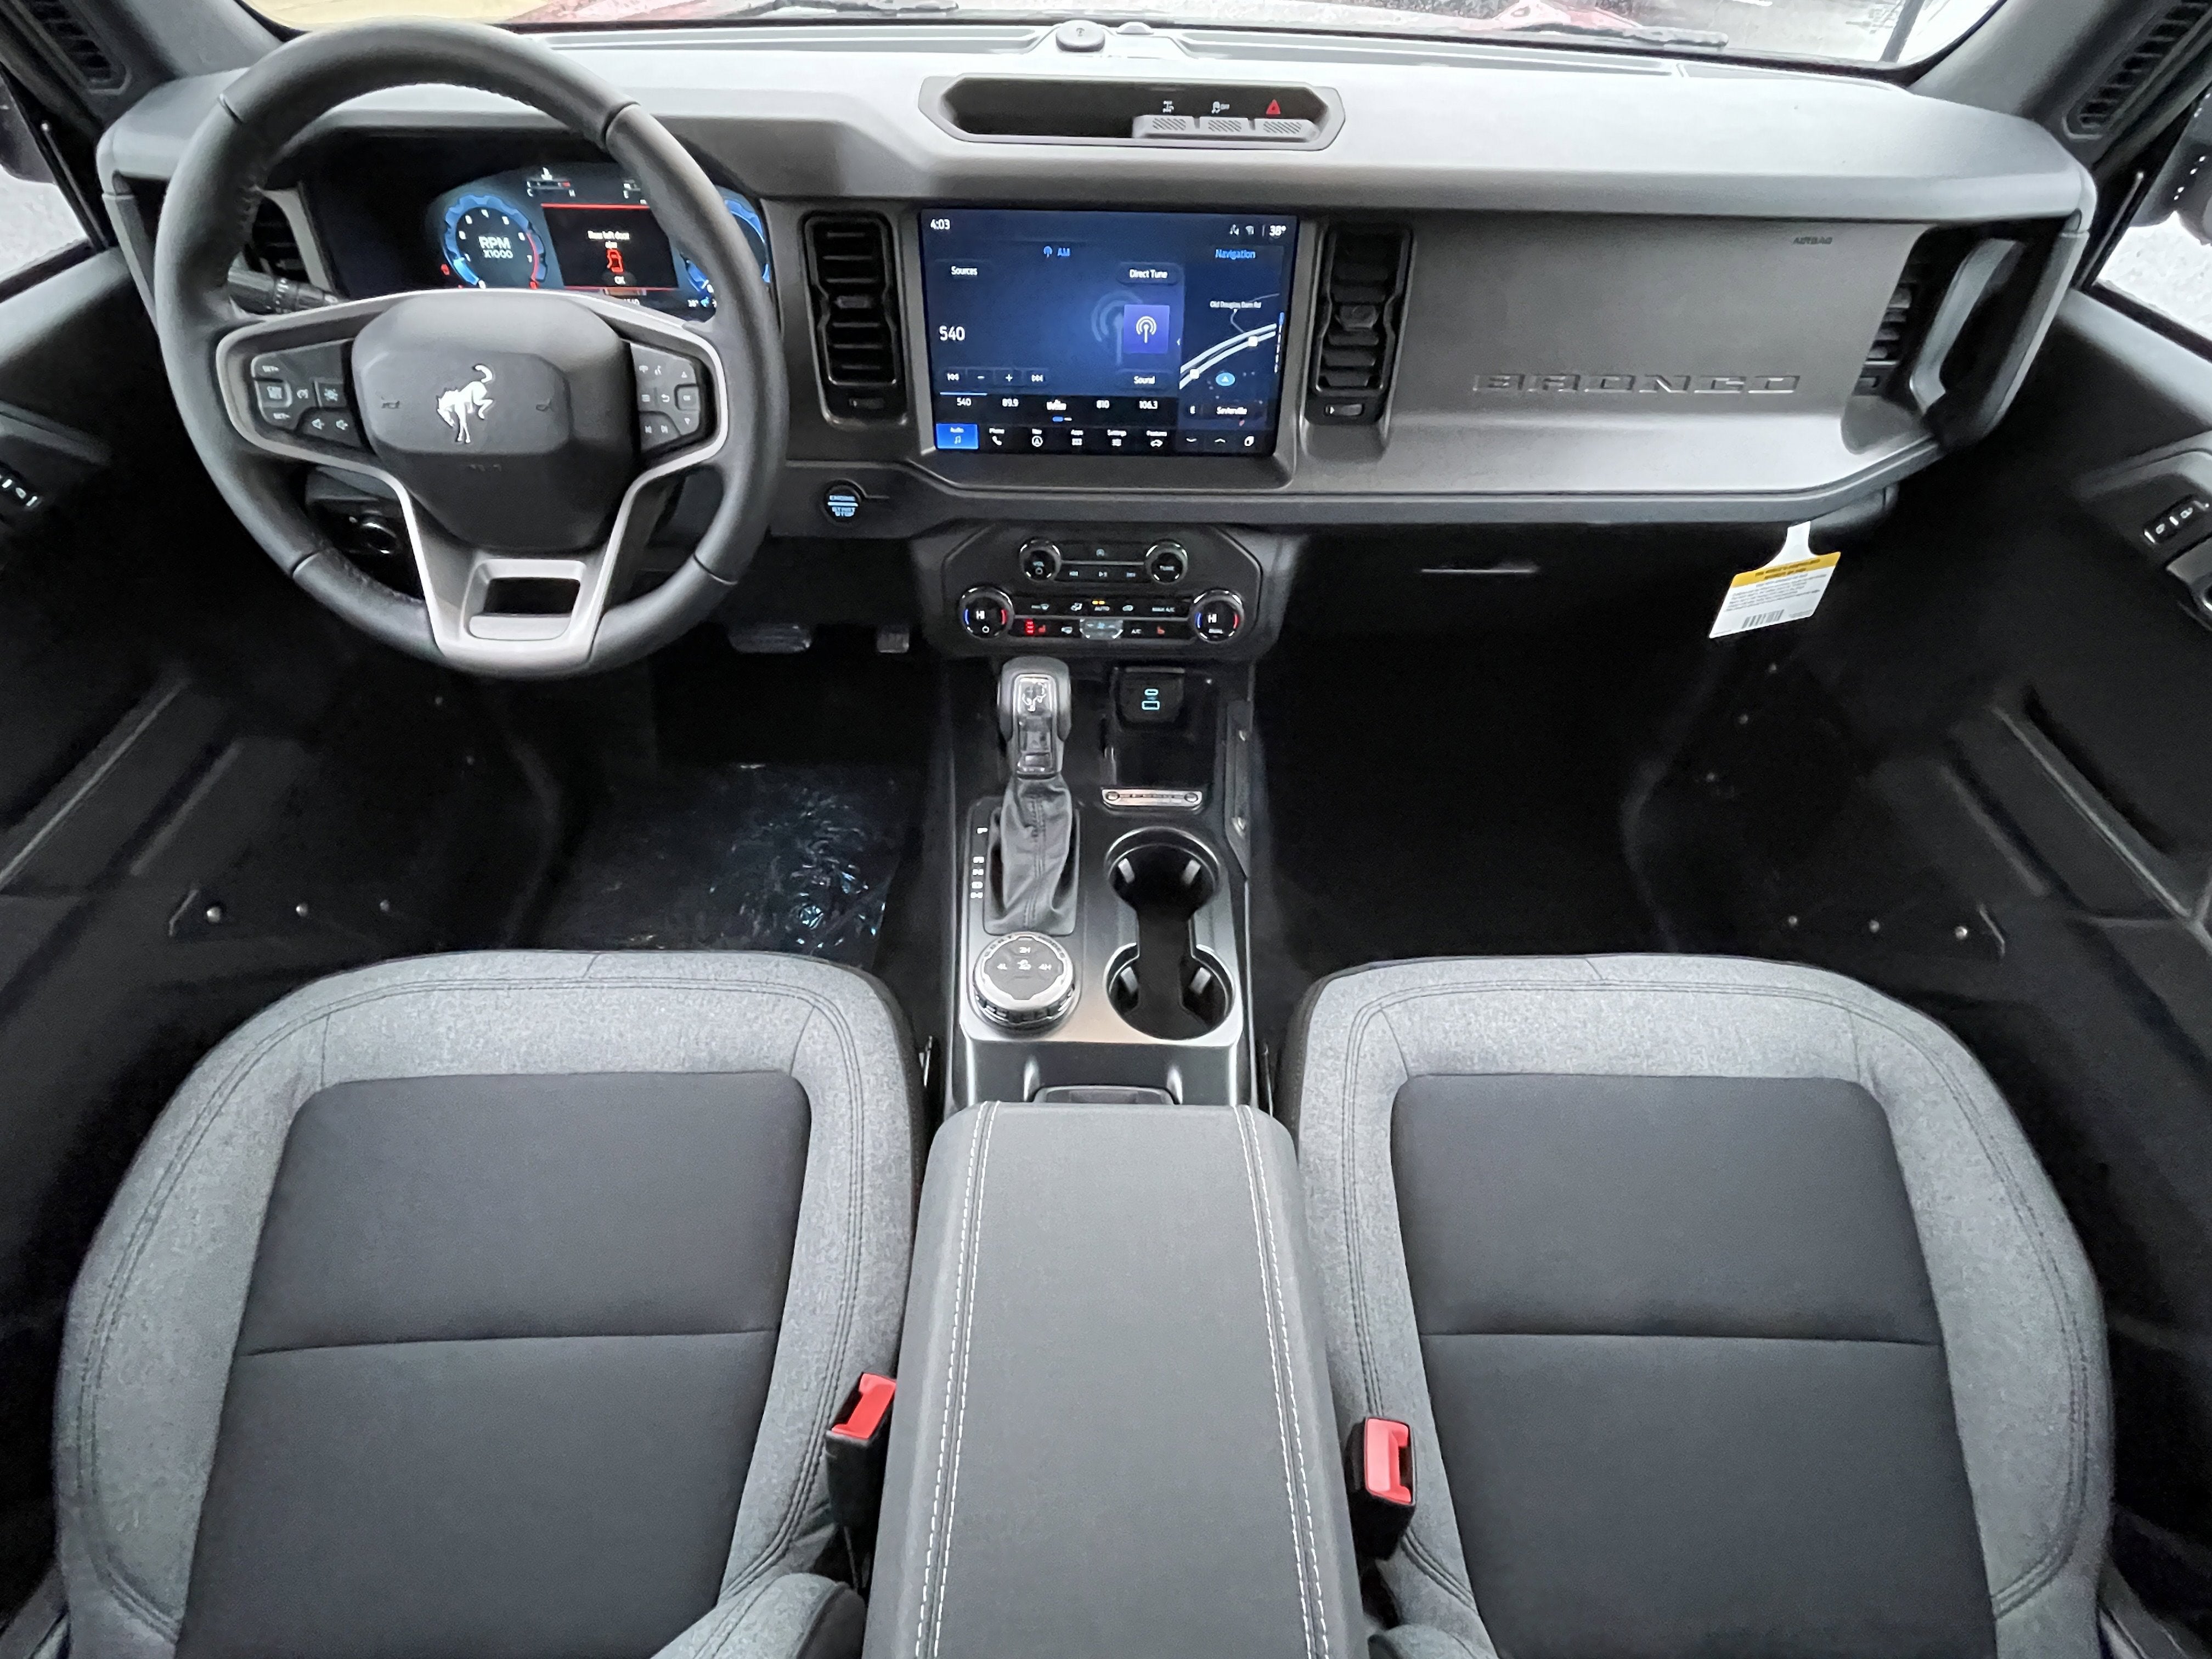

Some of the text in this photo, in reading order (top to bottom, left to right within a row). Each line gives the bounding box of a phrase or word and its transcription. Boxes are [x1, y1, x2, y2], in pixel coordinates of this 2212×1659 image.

[930, 219, 950, 230] 4:03
[478, 236, 511, 249] RPM
[1057, 248, 1070, 257] AM
[1215, 249, 1256, 260] Navigation
[951, 266, 978, 275] Sources
[1129, 269, 1168, 279] Direct Tune
[939, 326, 966, 341] 540
[1133, 376, 1155, 384] Sound
[1472, 373, 1800, 394] BRONCO
[957, 398, 972, 407] 540
[1002, 398, 1019, 407] 89.9
[1139, 400, 1158, 409] 106.3
[976, 610, 985, 620] HI
[1208, 613, 1217, 623] HI
